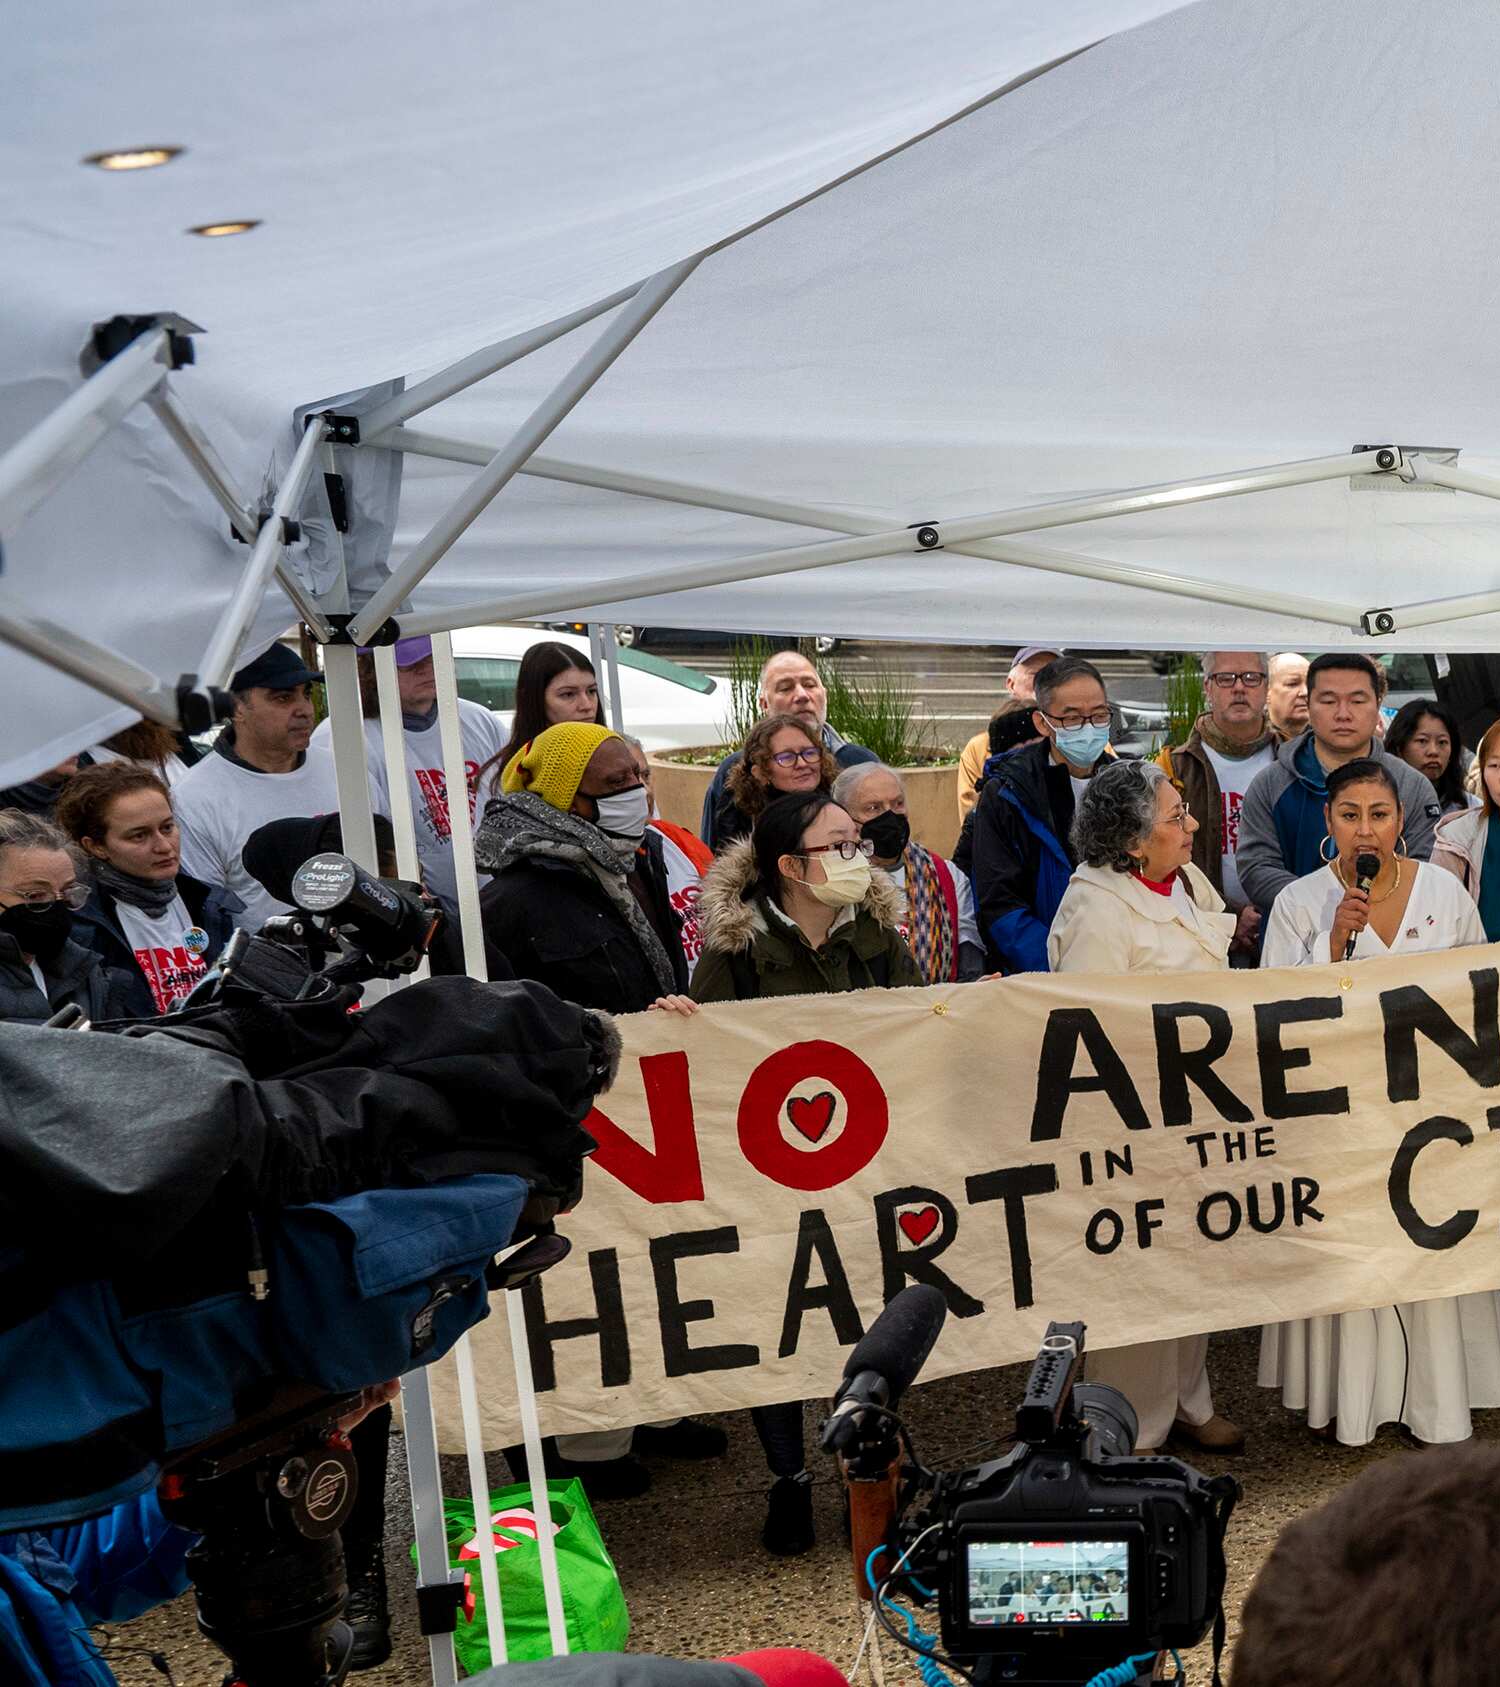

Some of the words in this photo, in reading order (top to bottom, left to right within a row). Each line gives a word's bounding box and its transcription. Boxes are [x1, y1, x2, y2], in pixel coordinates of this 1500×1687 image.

[578, 1040, 889, 1206] NO
[1080, 1144, 1134, 1186] IN
[1186, 1126, 1277, 1169] THE
[1085, 1198, 1165, 1255] OF
[1197, 1177, 1325, 1242] OUR
[521, 1163, 1060, 1393] HEART
